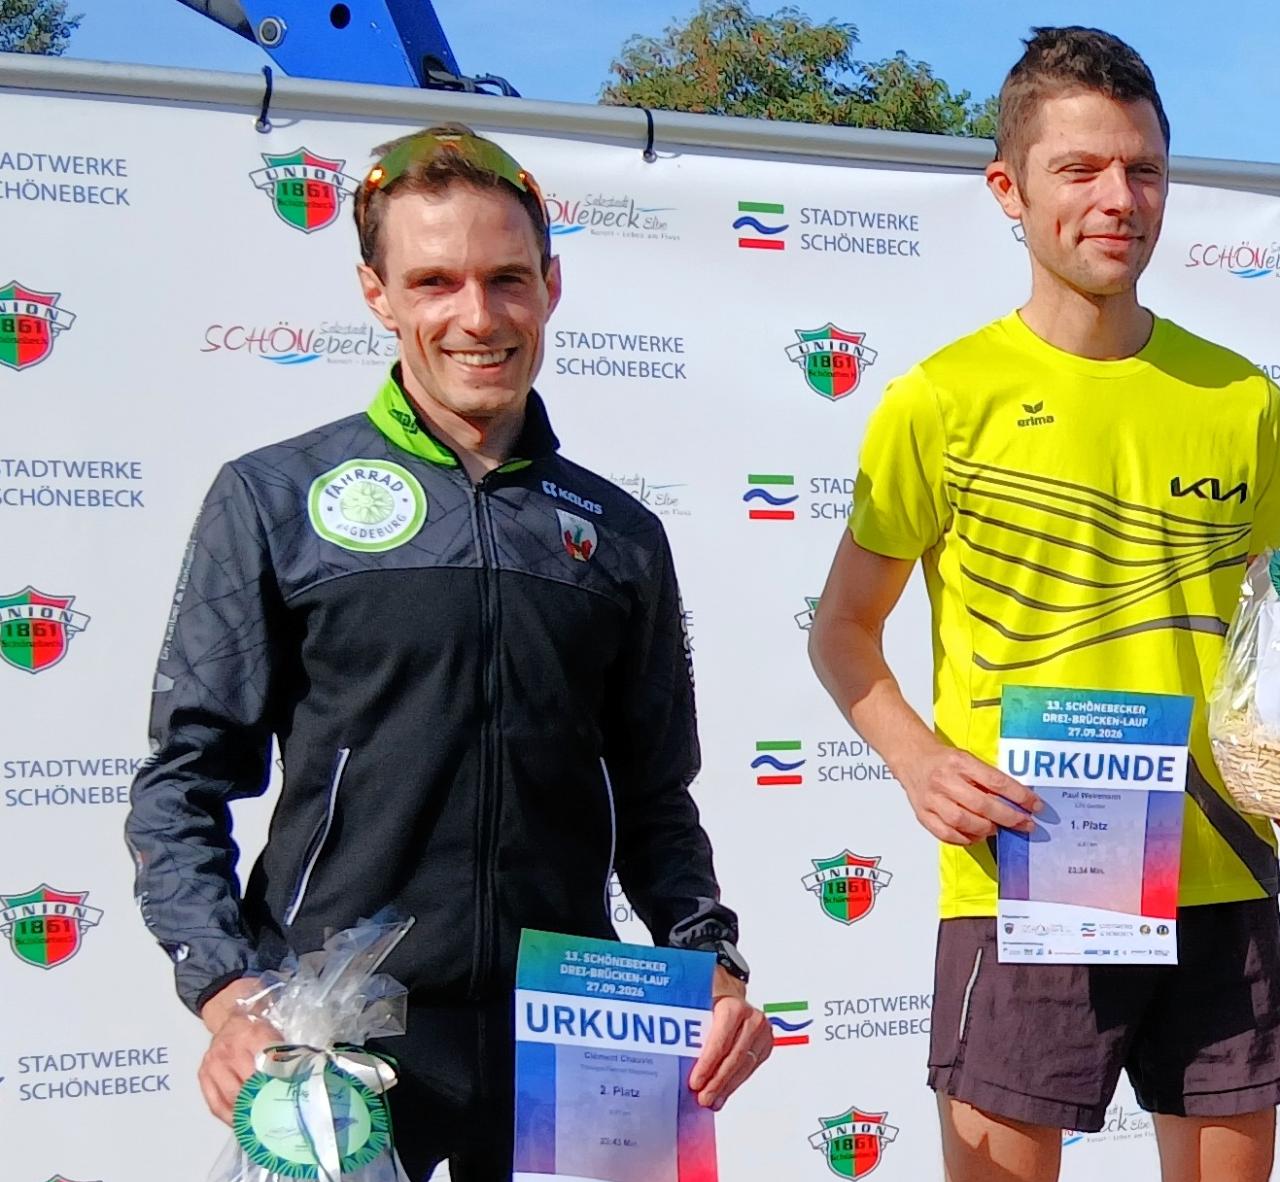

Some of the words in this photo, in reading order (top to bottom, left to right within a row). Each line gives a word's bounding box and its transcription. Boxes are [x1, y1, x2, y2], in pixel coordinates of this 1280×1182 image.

[0, 152, 128, 177] ADTWERKE
[265, 165, 345, 186] UNION
[280, 182, 331, 199] 1861
[548, 193, 640, 229] ÖNebeck
[800, 207, 919, 232] STADTWERKE
[800, 231, 920, 257] SCHÖNEBECK
[0, 299, 59, 320] NION
[0, 318, 43, 334] 861
[200, 321, 379, 356] SCHÖNebeck
[555, 331, 684, 354] STADTWERKE
[798, 342, 865, 357] UNION
[556, 355, 687, 380] SCHÖNEBECK
[811, 354, 853, 369] 1861
[1017, 415, 1055, 428] erima
[0, 459, 143, 480] TADTWERKE
[325, 468, 405, 500] FAHRRAD
[0, 485, 145, 508] CHÖNEBECK
[6, 621, 57, 637] 1861
[1065, 700, 1146, 715] SCHÖNEBECKER
[1042, 712, 1149, 727] DREI-BRÜCKEN-LAUF
[1067, 727, 1123, 739] 27.09.2026
[817, 740, 872, 758] STADT
[4, 758, 143, 779] STADTWERK
[818, 760, 897, 782] SCHÖNE
[1008, 749, 1176, 783] URKUNDE
[6, 782, 128, 806] SCHÖNEBE
[1070, 820, 1080, 830] 1.
[1082, 820, 1109, 831] Platz
[815, 867, 880, 882] UNION
[828, 880, 869, 894] 1861
[3, 902, 88, 923] UNION
[19, 918, 71, 935] 1861
[583, 952, 667, 973] SCHÖNEBECKER
[560, 965, 671, 986] DREI-BRÜCKEN-LAUF
[824, 994, 933, 1017] STADTWERK
[525, 1002, 704, 1048] URKUNDE
[825, 1016, 932, 1041] SCHÖNEBEC
[18, 1047, 169, 1074] STADTWERKE
[20, 1073, 171, 1101] SCHÖNEBECK
[612, 1085, 641, 1097] Platz
[822, 1124, 886, 1140] UNION
[833, 1137, 875, 1152] 1861
